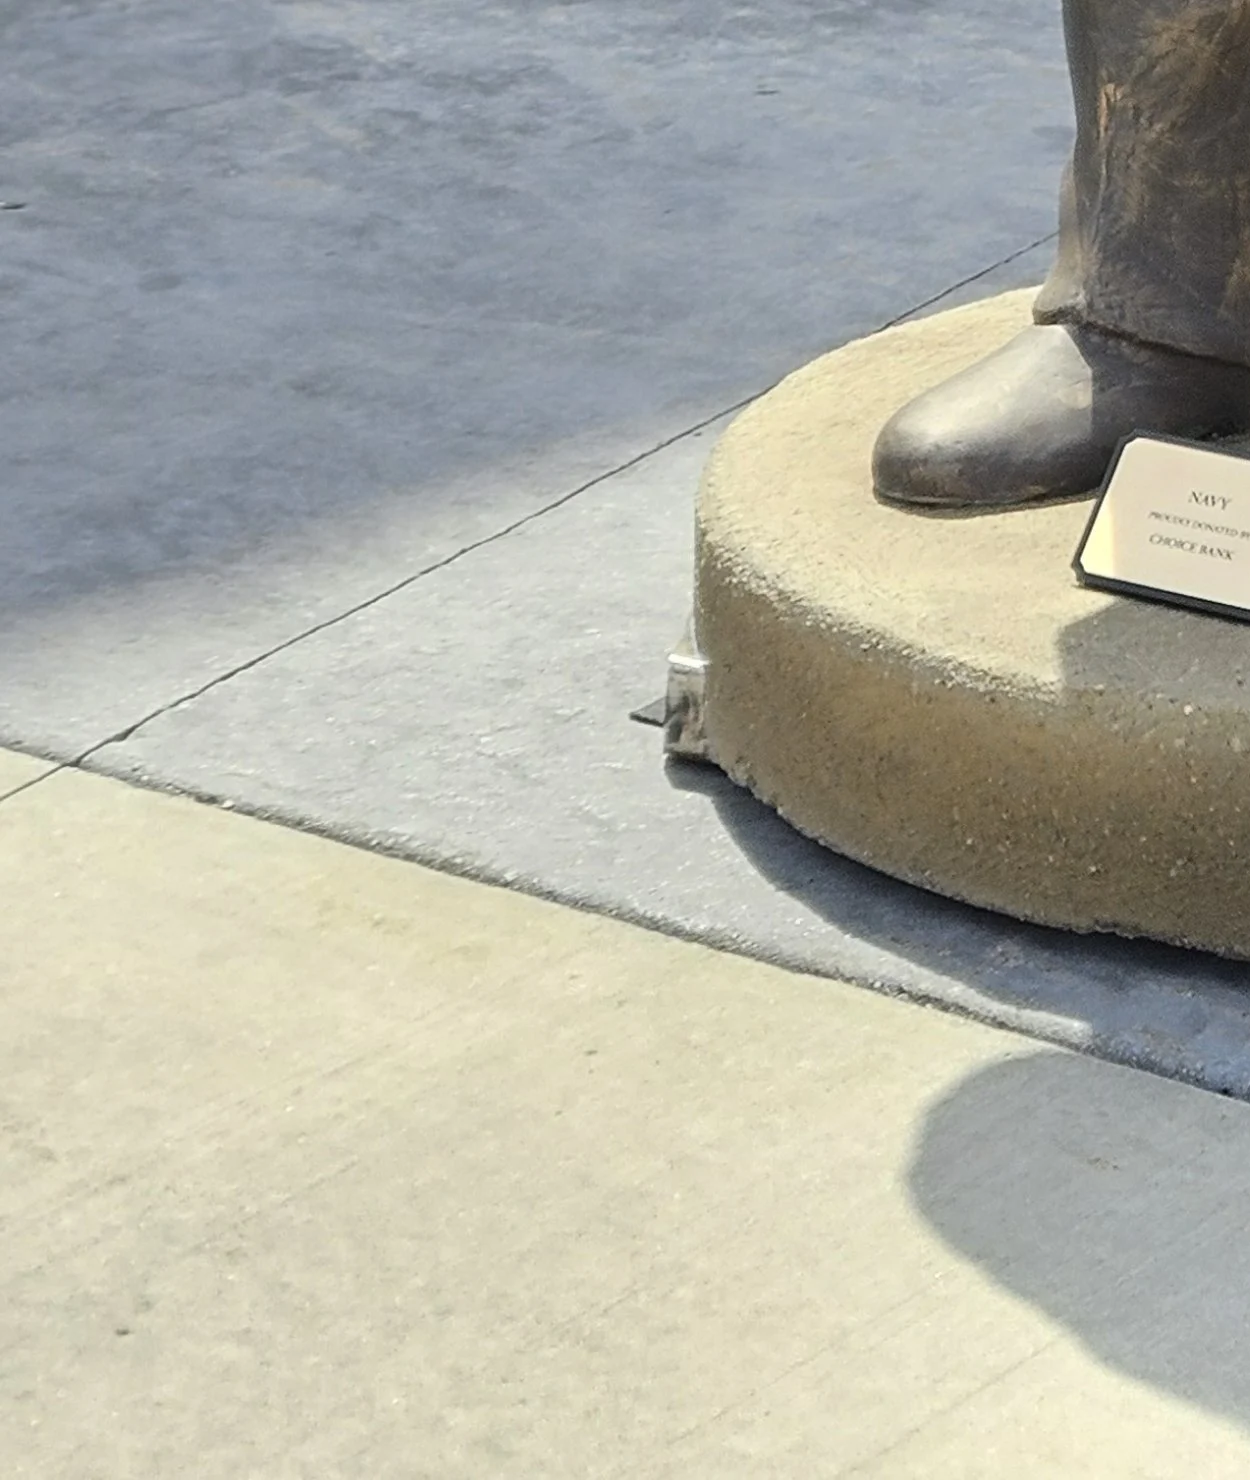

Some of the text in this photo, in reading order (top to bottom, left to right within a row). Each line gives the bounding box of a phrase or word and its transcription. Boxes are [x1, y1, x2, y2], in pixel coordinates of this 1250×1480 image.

[1188, 490, 1233, 511] NAVY
[1191, 520, 1239, 538] DONATED
[1149, 533, 1236, 561] CHOICE BANK
